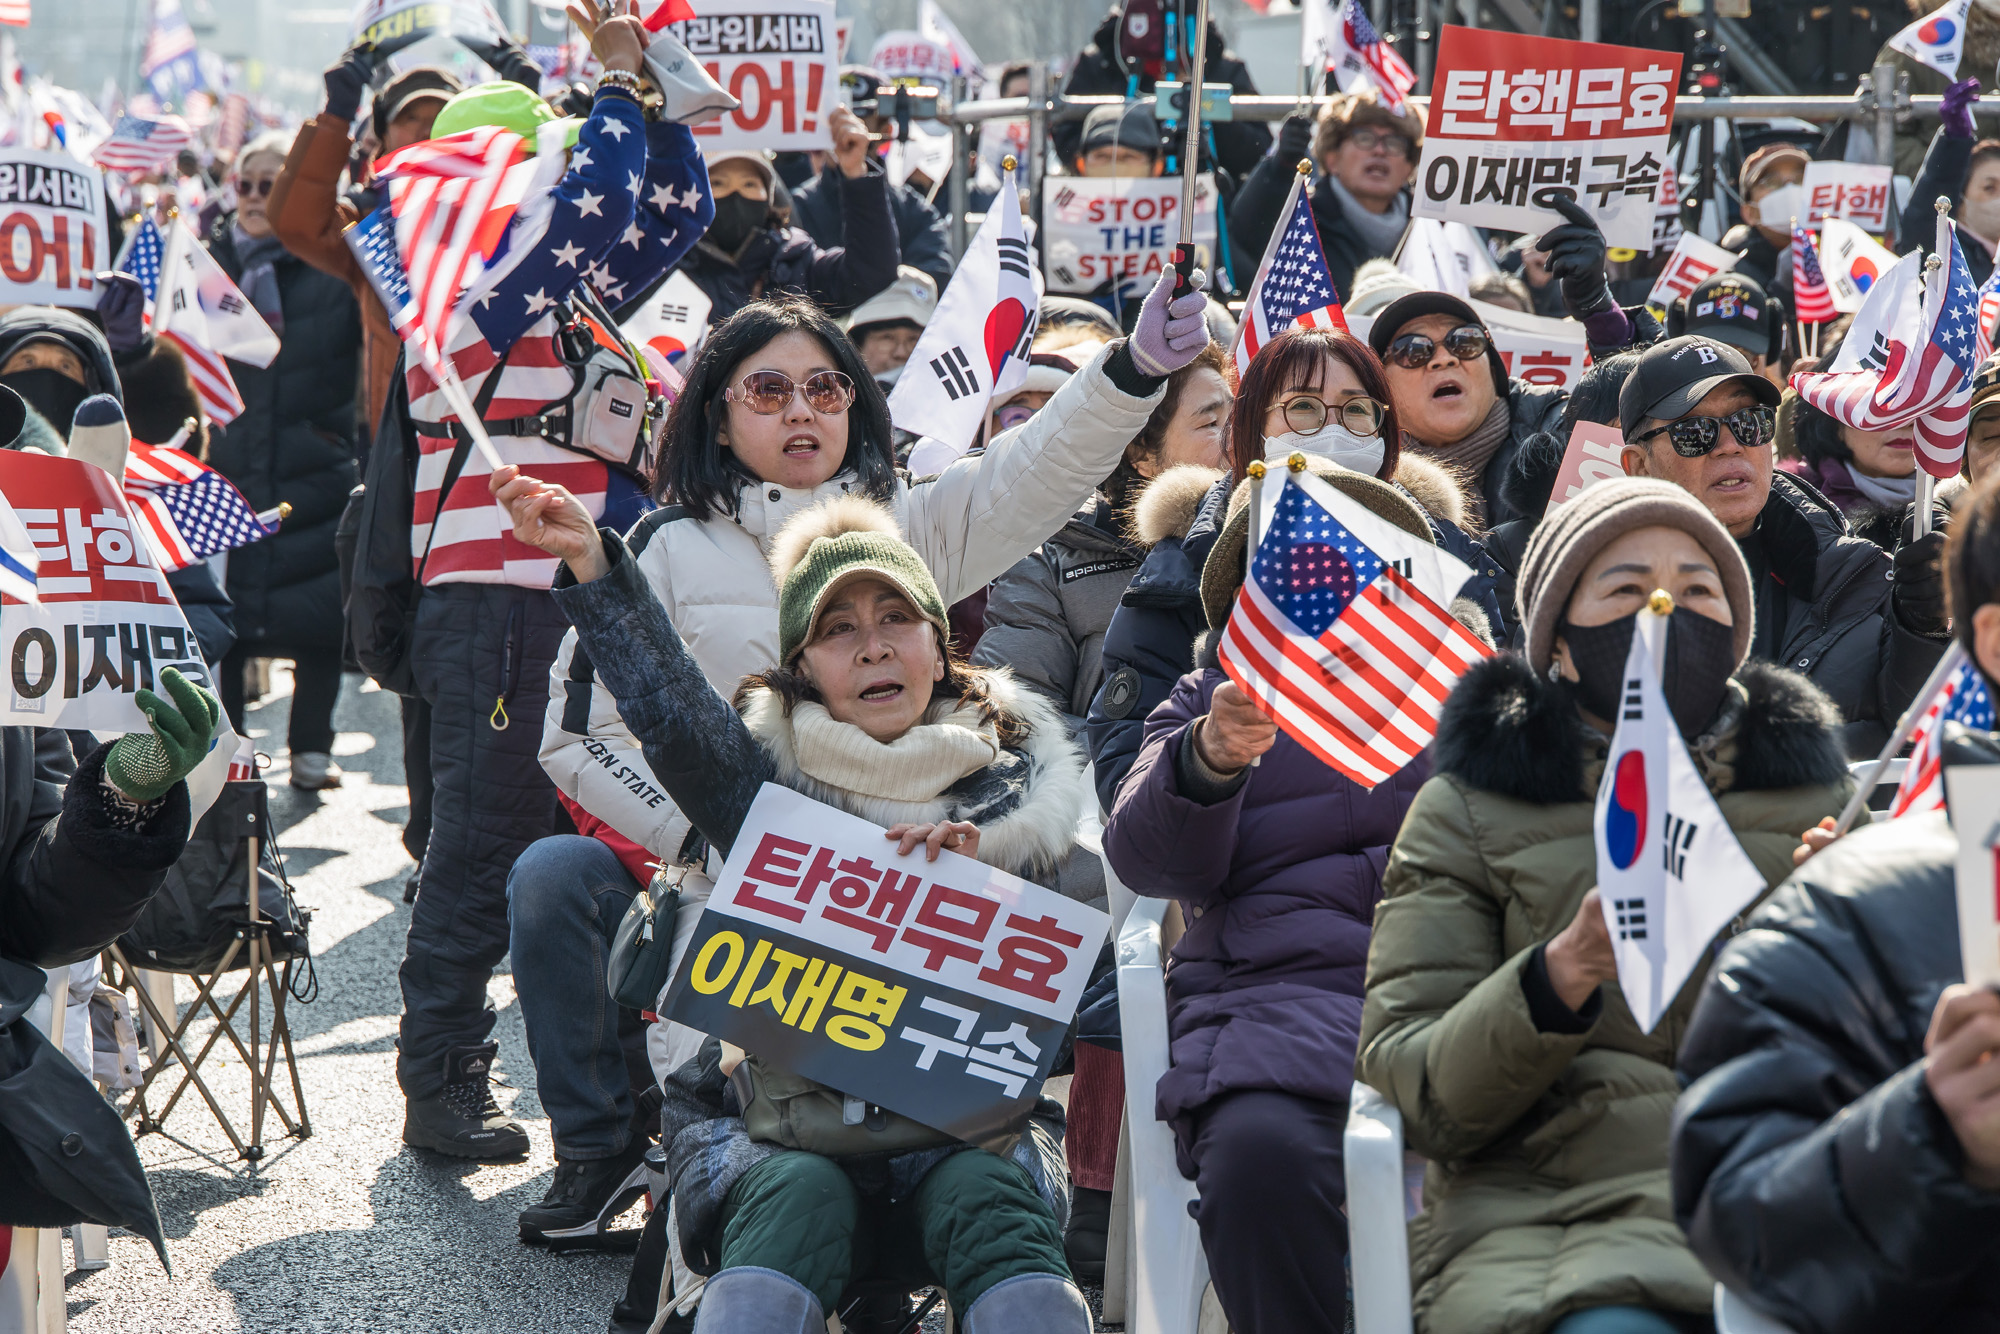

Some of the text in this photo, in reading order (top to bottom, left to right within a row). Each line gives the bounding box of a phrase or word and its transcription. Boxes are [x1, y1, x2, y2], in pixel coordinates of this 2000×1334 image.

[1440, 64, 1674, 137] 탄핵무효
[1425, 151, 1662, 210] 이재명 구속
[1088, 196, 1178, 222] STOP
[1808, 184, 1888, 225] 탄핵
[1100, 225, 1165, 250] THE
[1671, 341, 1707, 360] BOSTON
[1695, 346, 1719, 365] B
[612, 766, 667, 809] STATE
[733, 832, 1084, 1004] 탄핵무효
[690, 930, 1042, 1100] 이재명 구속
